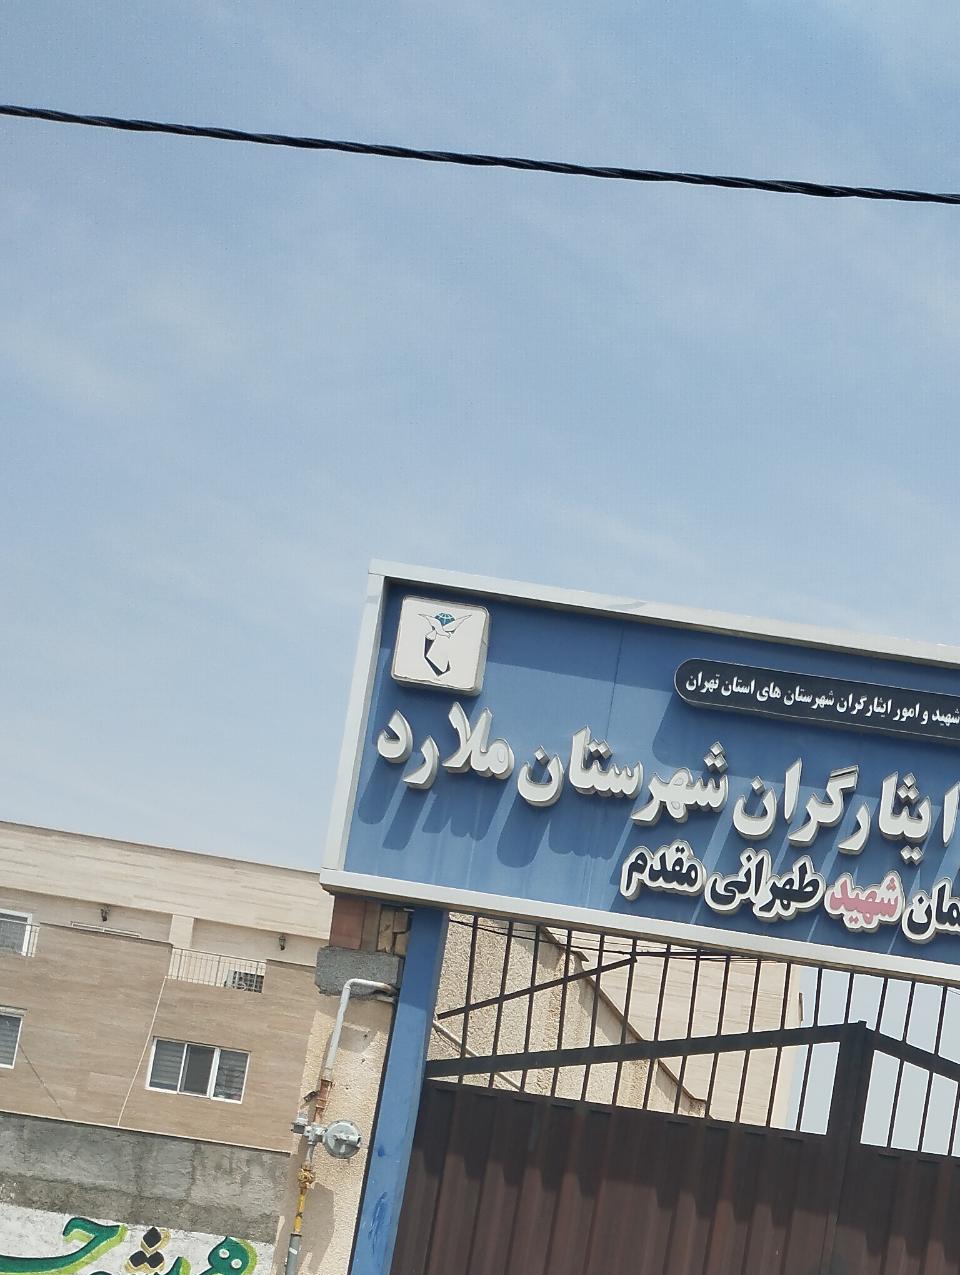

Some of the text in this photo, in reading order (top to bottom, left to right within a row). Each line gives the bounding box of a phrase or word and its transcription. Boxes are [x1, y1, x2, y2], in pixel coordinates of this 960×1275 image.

[685, 671, 720, 693] تهران
[721, 676, 756, 697] استان
[756, 681, 782, 702] های
[783, 685, 835, 709] شهرستان
[836, 693, 892, 718] ایثارگران
[893, 702, 920, 722] امور
[920, 710, 929, 725] و
[931, 707, 960, 727] شهید
[376, 700, 515, 790] ملارد
[517, 725, 729, 825] شهرستان
[732, 757, 960, 868] ایثارگران
[625, 842, 701, 891] مقدم
[708, 848, 820, 915] طهرانی
[827, 874, 902, 926] شهید
